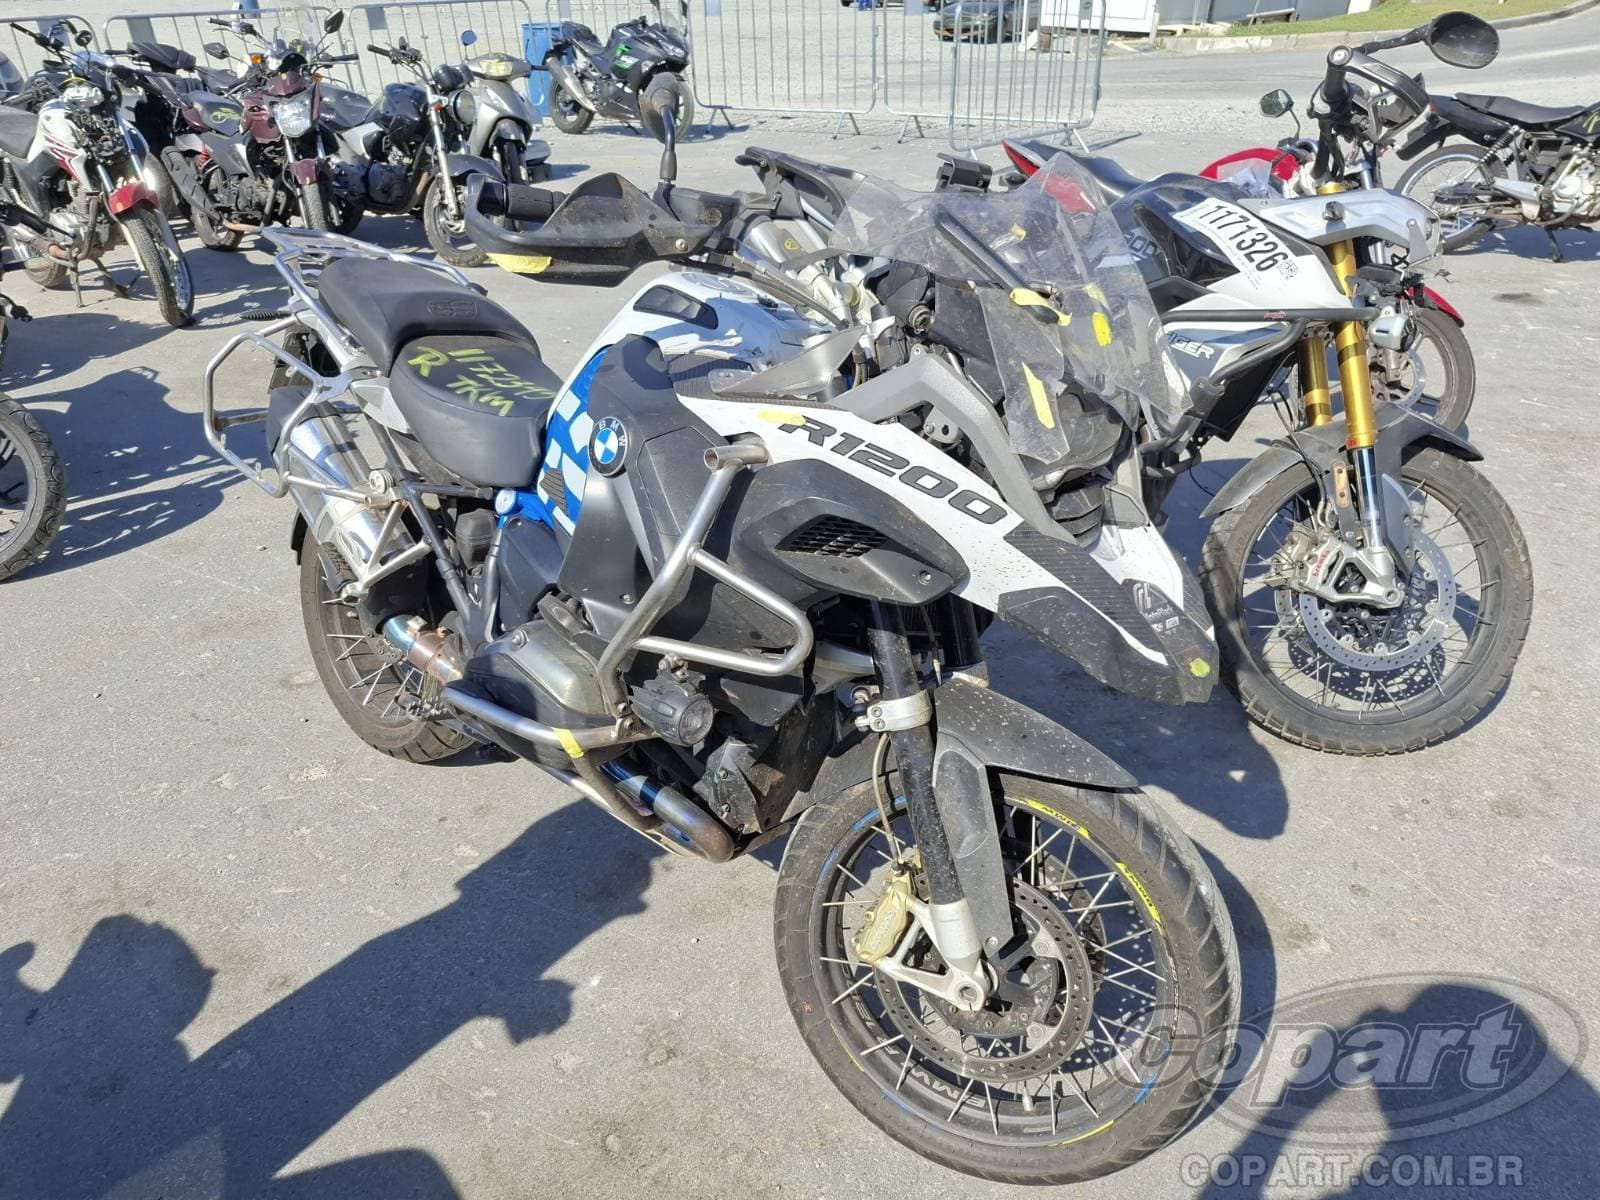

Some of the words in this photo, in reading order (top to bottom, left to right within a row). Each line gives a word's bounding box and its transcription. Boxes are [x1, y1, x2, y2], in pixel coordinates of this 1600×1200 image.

[1198, 204, 1290, 272] 1171326
[598, 419, 627, 447] BMW
[777, 414, 1008, 525] R1200
